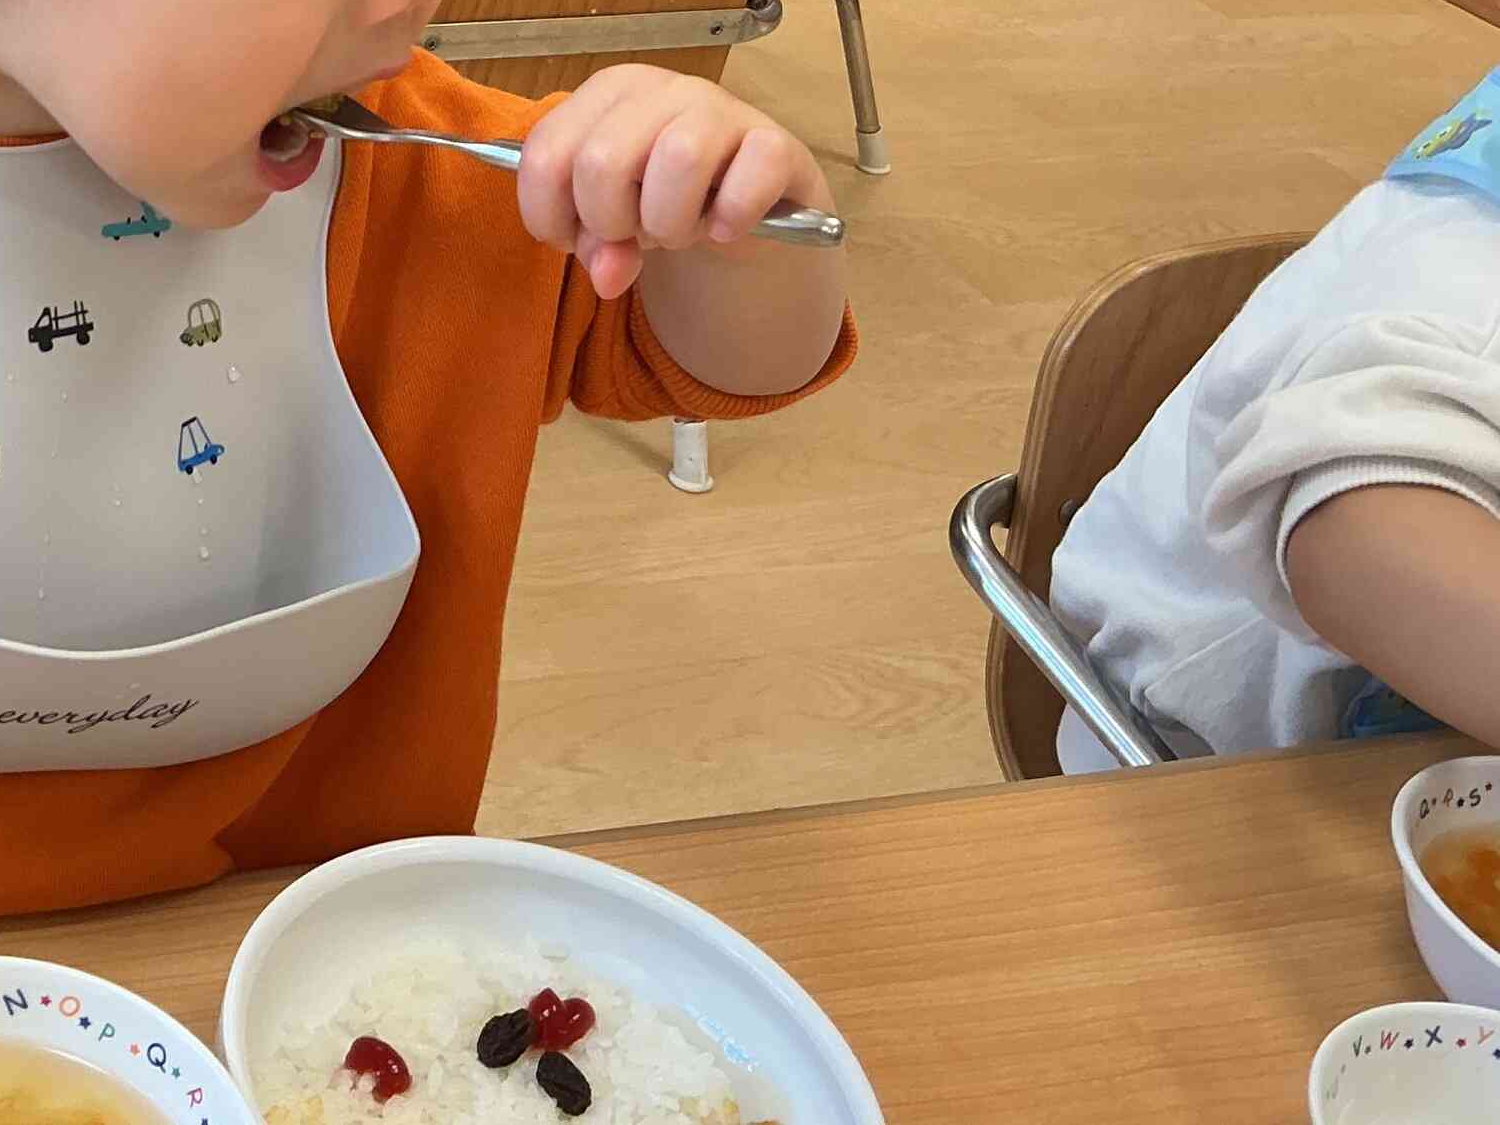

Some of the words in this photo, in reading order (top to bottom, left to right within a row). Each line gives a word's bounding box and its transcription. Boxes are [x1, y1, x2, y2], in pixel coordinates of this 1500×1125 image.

[1468, 787, 1482, 808] S
[2, 988, 30, 1017] N
[58, 995, 82, 1018] O
[98, 1022, 116, 1042] P
[146, 1042, 168, 1074] Q
[186, 1087, 205, 1108] R
[1379, 1029, 1400, 1051] W
[1424, 1025, 1444, 1048] X
[1477, 1027, 1496, 1045] Y
